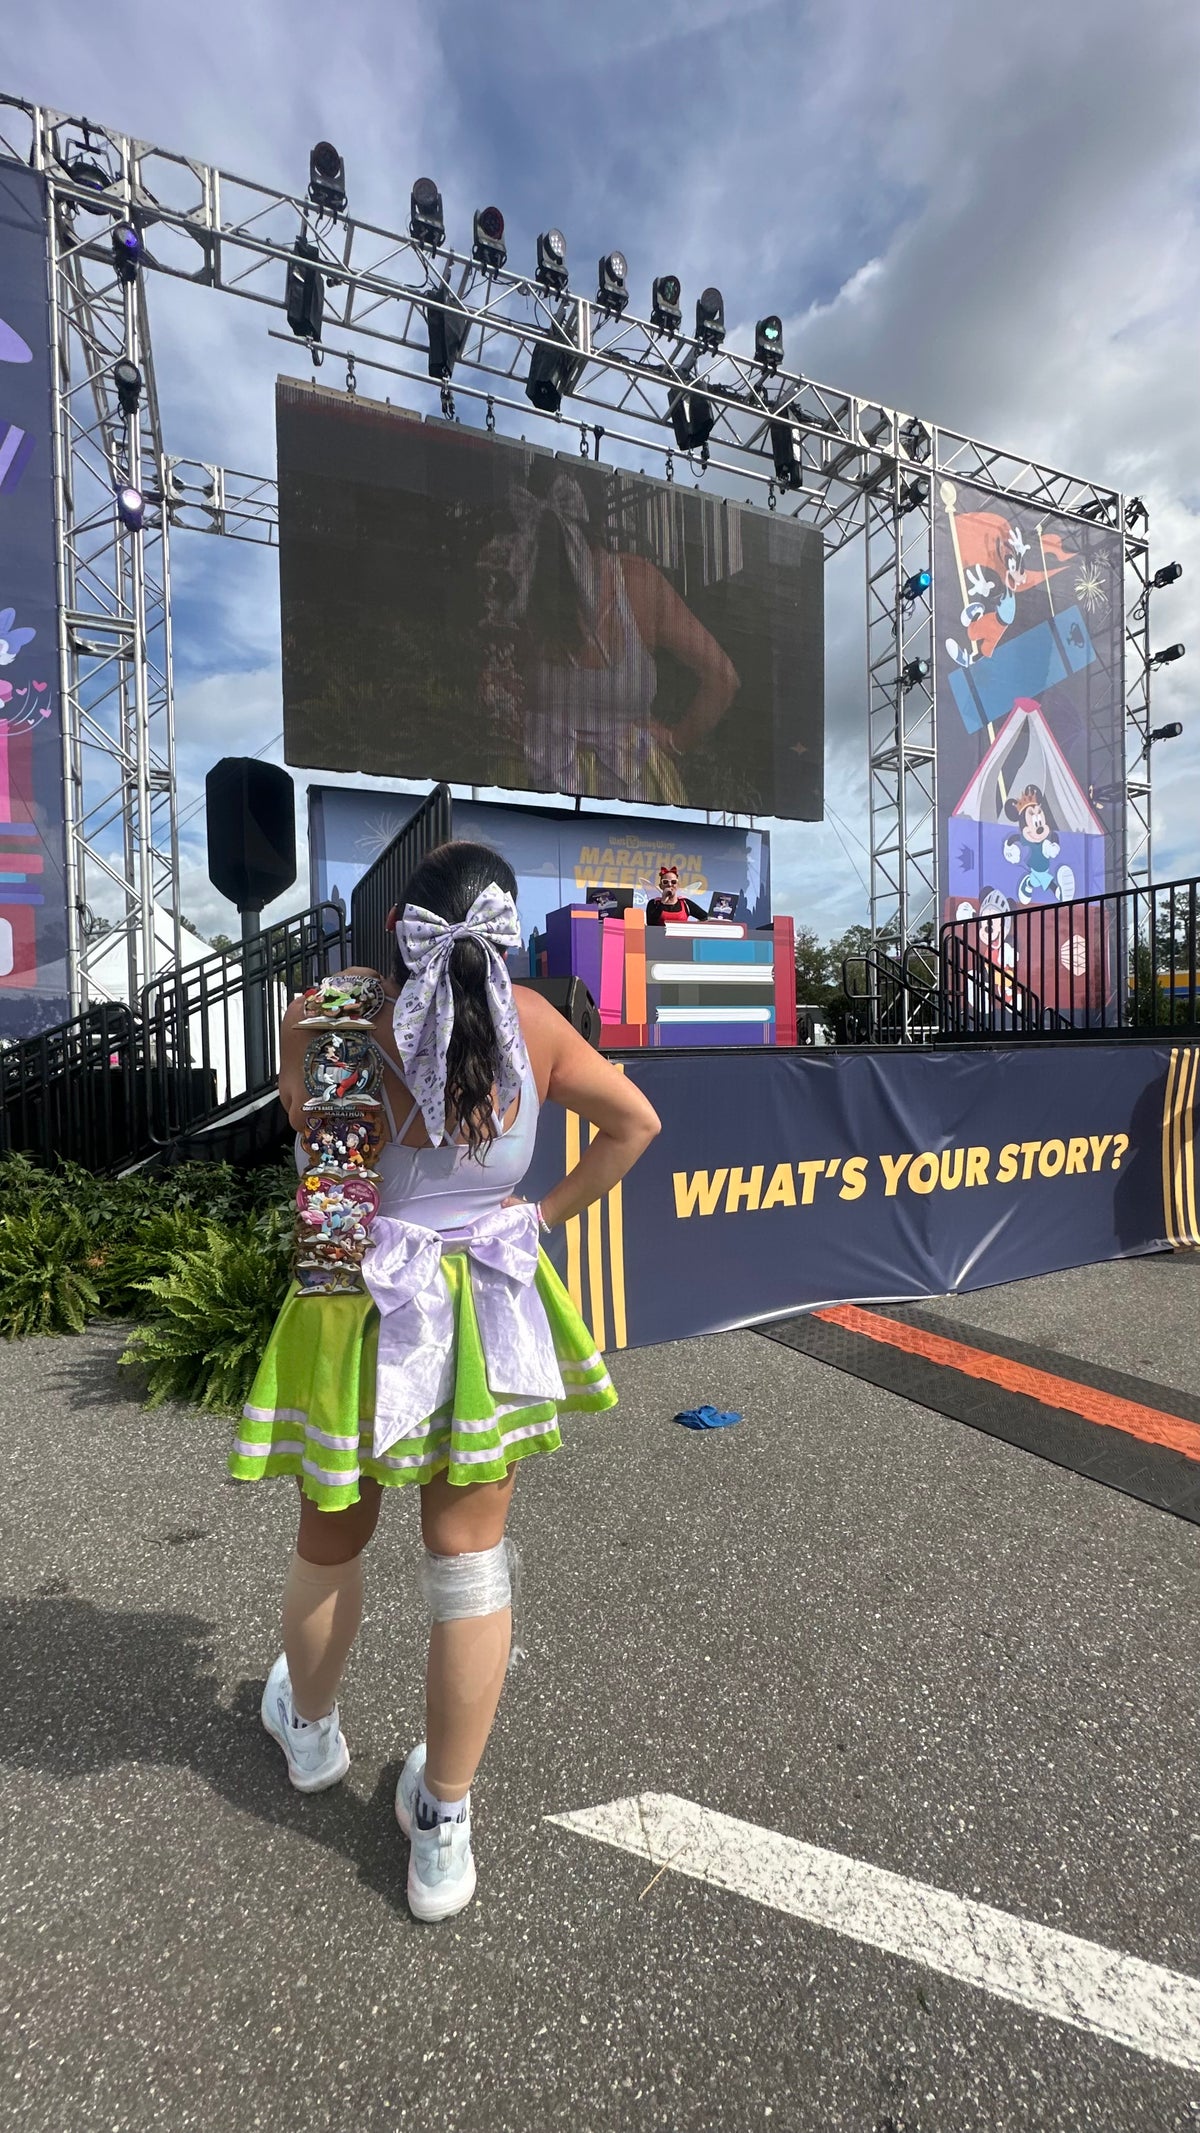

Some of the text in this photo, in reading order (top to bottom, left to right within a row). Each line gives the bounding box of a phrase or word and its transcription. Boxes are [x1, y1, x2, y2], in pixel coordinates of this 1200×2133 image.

[580, 846, 703, 872] MARATHON
[672, 1133, 1129, 1218] WHAT'S YOUR STORY?
